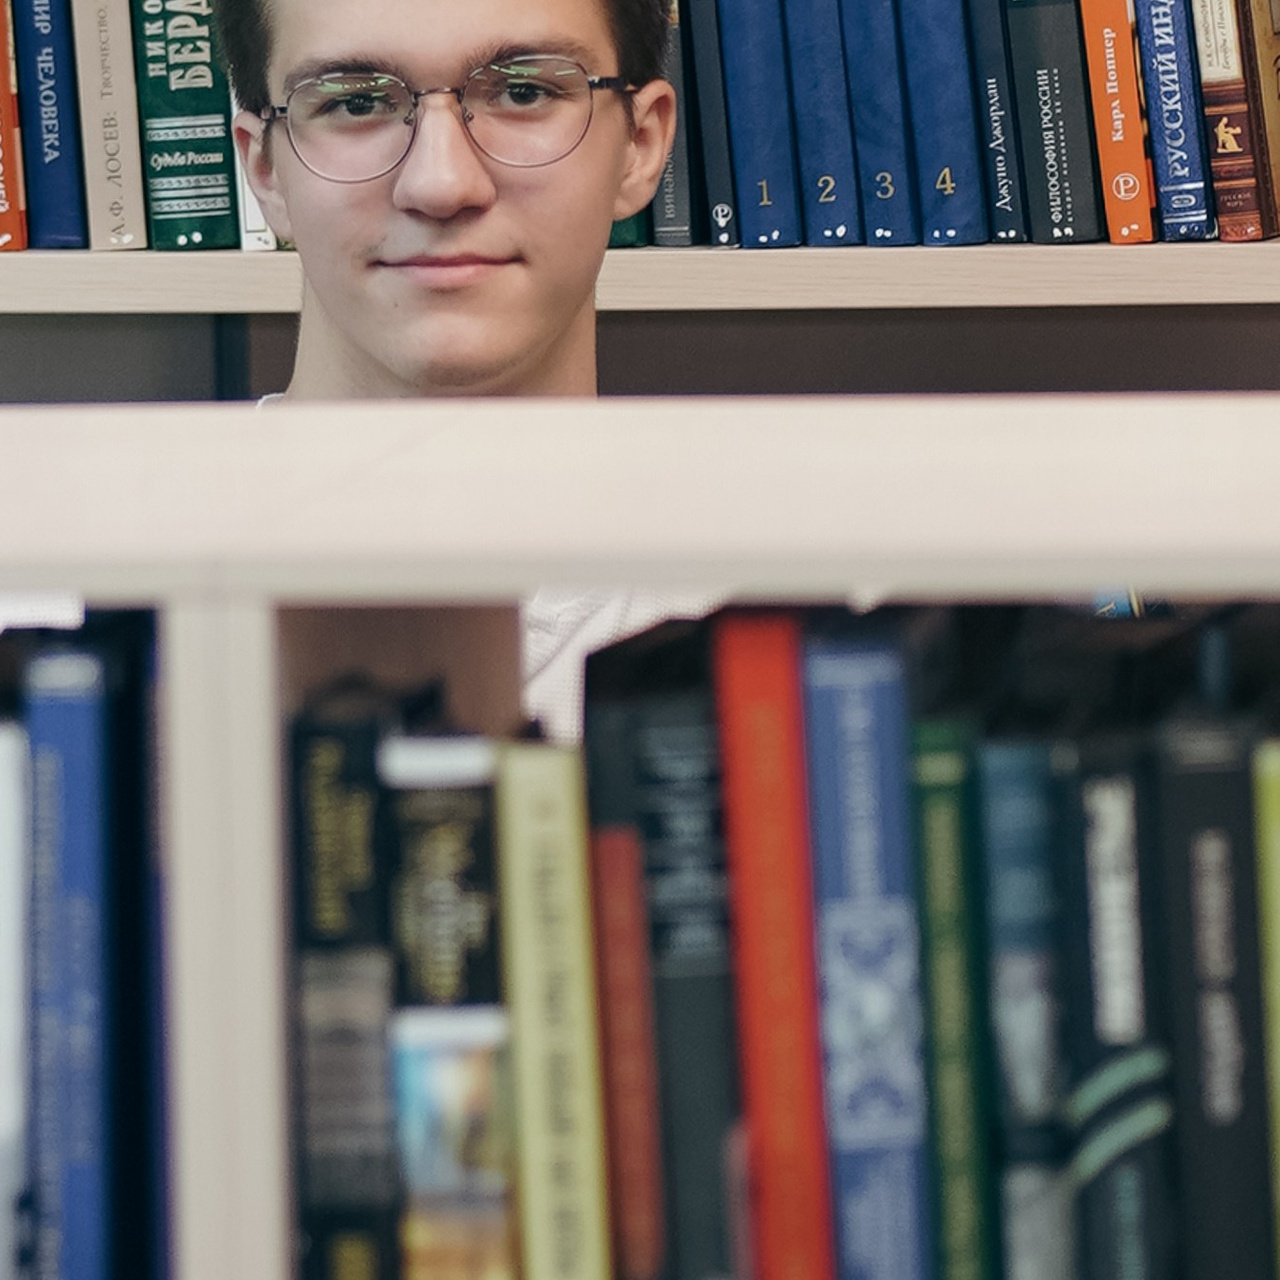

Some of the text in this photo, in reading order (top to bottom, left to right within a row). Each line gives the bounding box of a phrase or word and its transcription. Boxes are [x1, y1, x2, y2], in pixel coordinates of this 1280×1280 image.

[35, 46, 61, 164] ЧЕЛОВЕКА
[1101, 28, 1126, 143] Карл Поппер
[1152, 52, 1190, 180] РУССКИЙ
[756, 178, 773, 208] 1
[817, 174, 837, 205] 2
[875, 171, 895, 200] 3
[934, 167, 956, 197] 4
[985, 77, 1013, 213] Джуно Джордан
[1036, 68, 1063, 224] ФИЛОСОФИЯ РОССИИ
